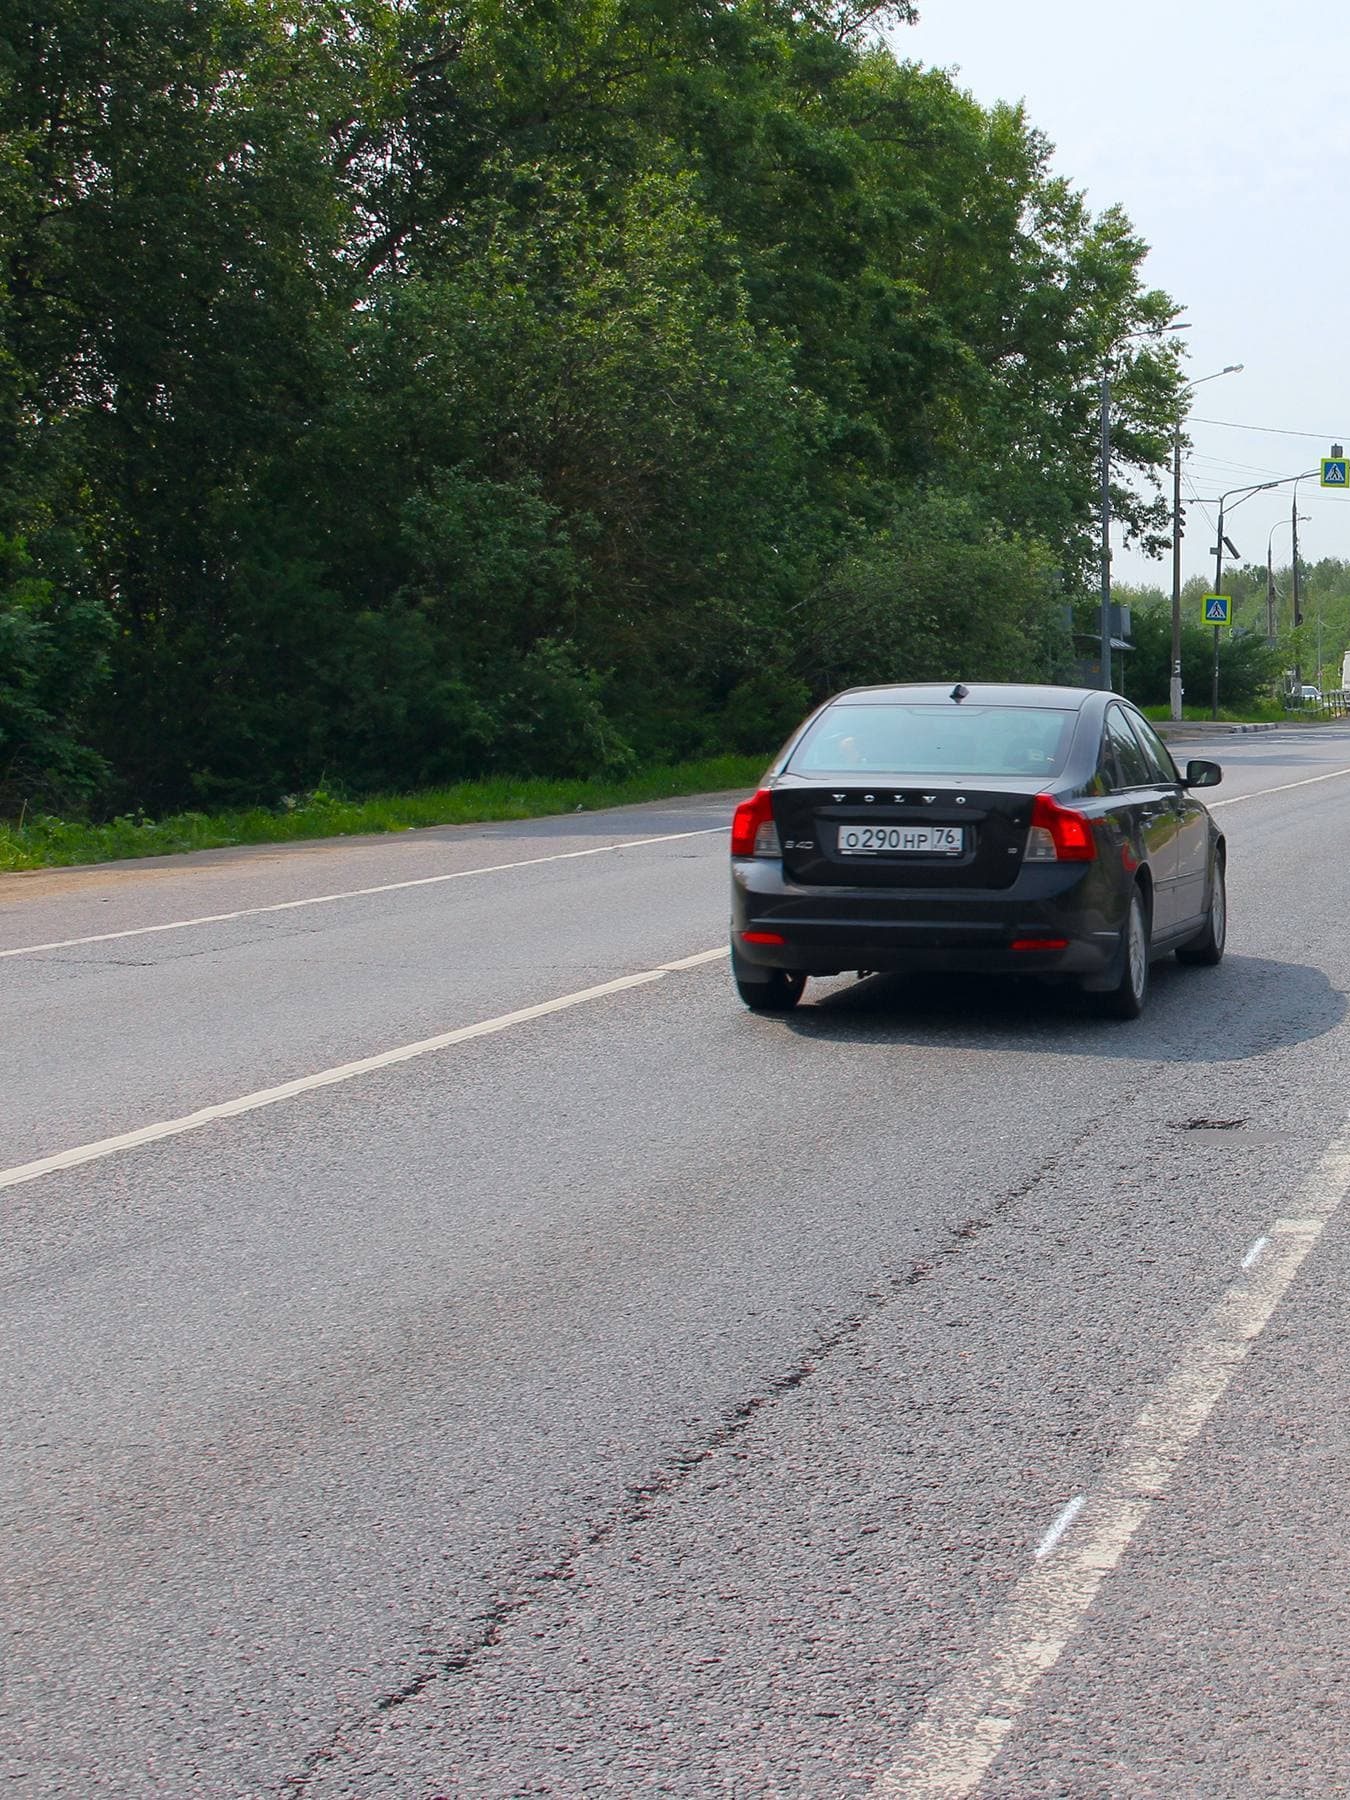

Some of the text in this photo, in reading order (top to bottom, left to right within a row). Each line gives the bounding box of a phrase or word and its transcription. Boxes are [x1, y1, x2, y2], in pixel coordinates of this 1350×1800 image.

[832, 794, 966, 804] VOLVO
[935, 829, 955, 844] 76
[785, 840, 815, 849] S40
